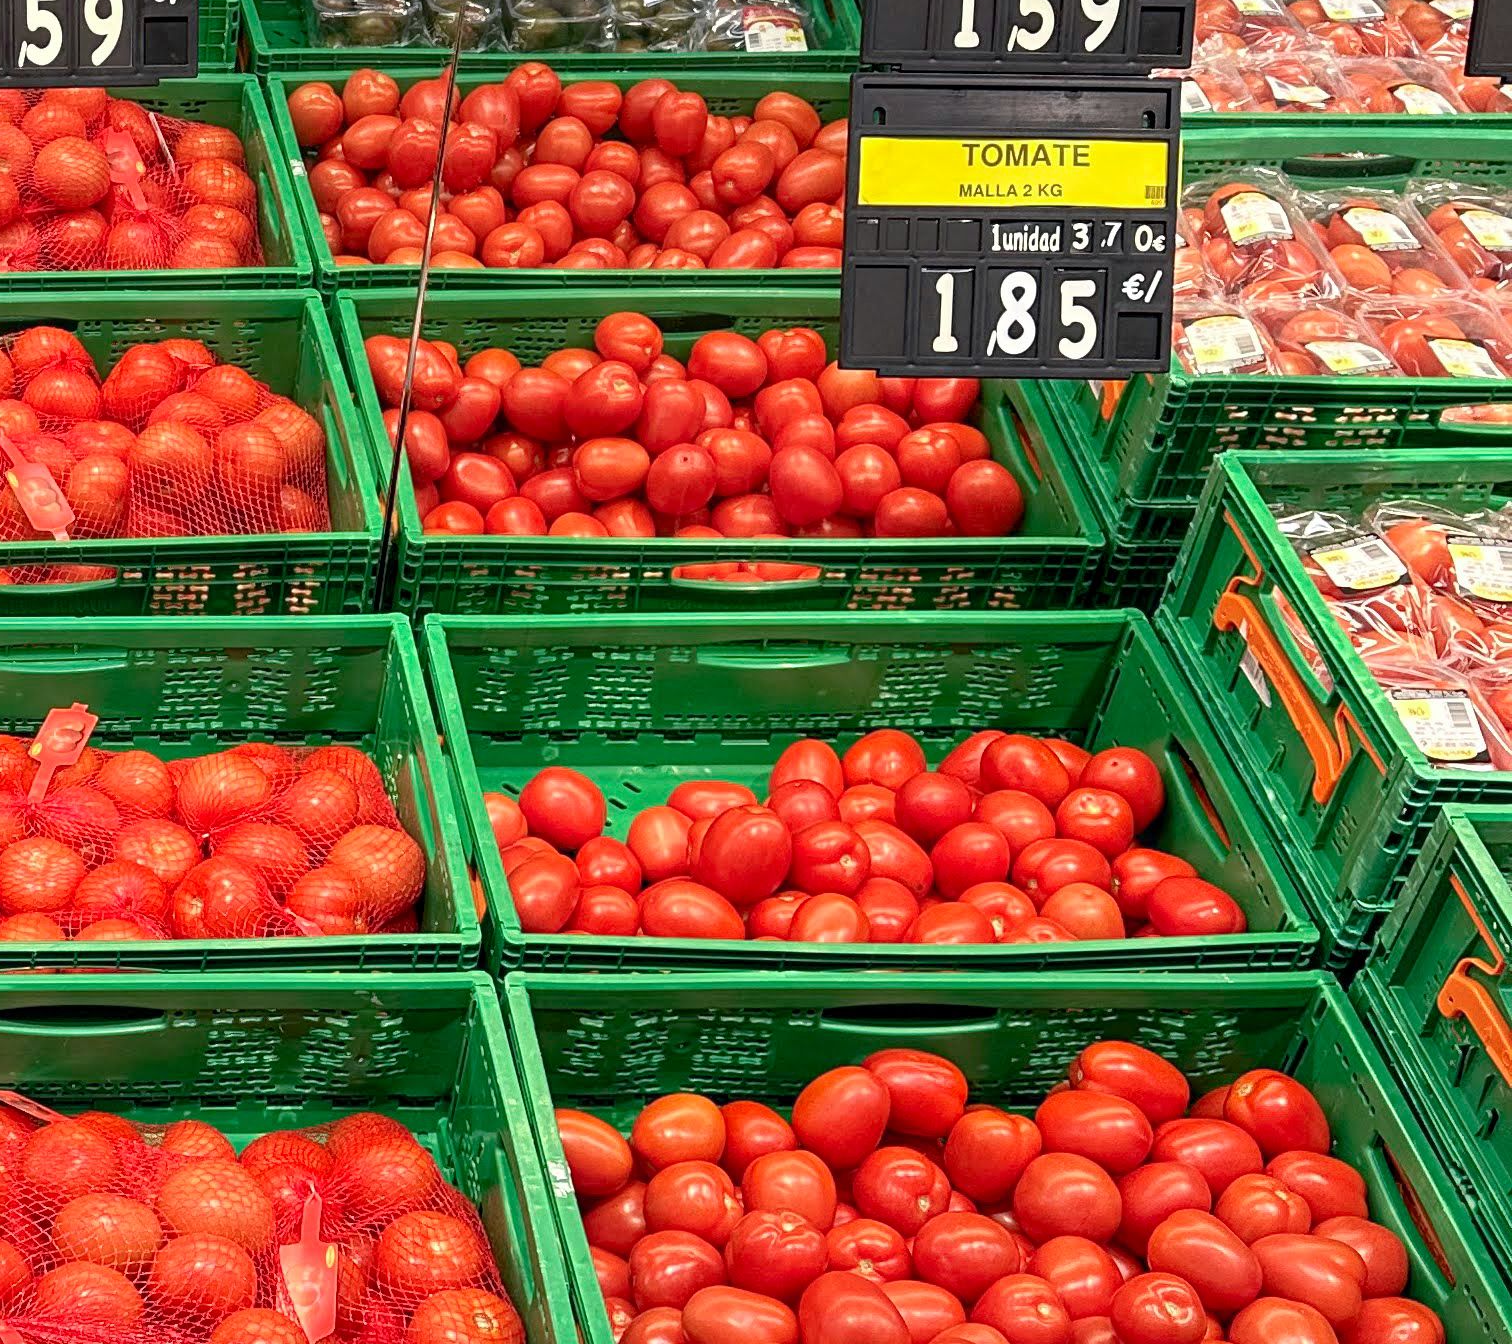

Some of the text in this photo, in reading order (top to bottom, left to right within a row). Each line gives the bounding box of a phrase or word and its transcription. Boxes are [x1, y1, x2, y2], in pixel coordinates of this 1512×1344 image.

[961, 143, 1091, 168] TOMATE
[959, 184, 1063, 198] MALLA 2 KG
[932, 270, 1098, 359] 1,85
